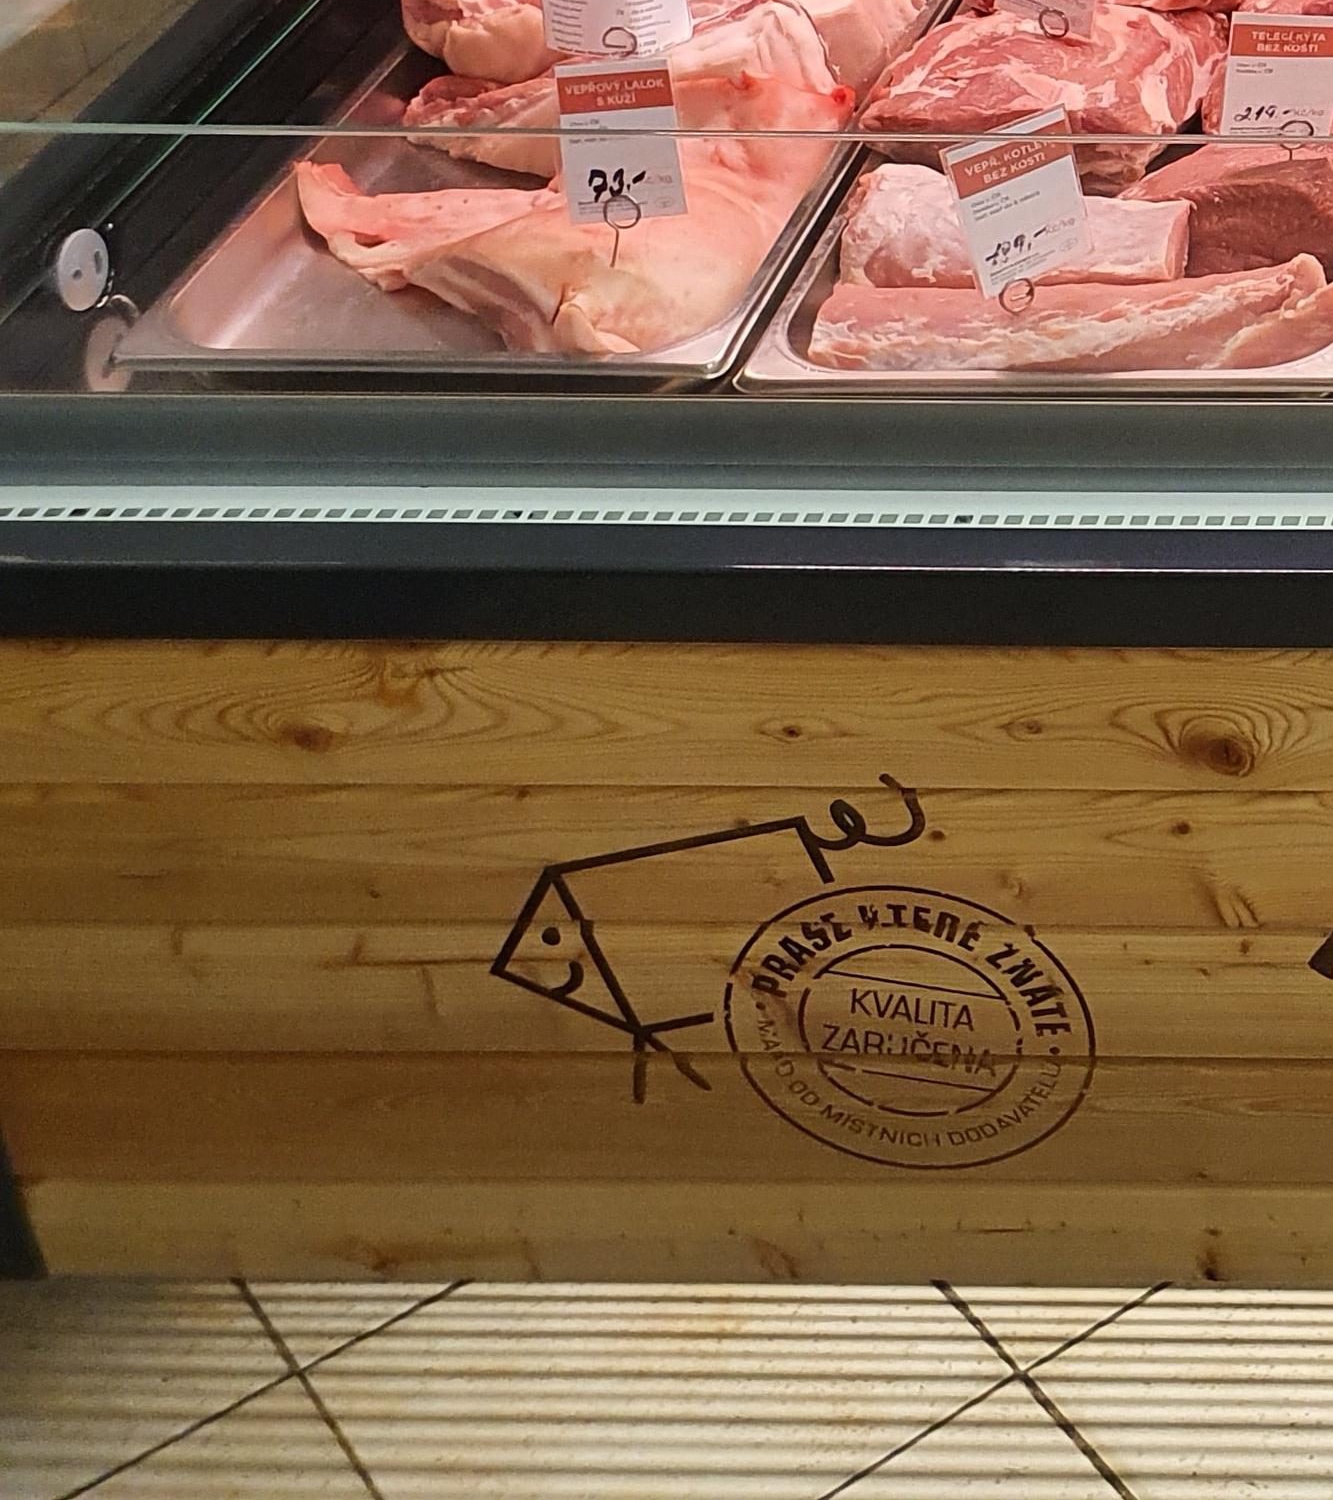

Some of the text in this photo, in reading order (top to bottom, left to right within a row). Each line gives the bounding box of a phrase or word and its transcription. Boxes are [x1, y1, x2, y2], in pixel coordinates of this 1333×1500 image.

[1256, 43, 1319, 53] BEZ KOSTI
[564, 77, 665, 96] VEPŘOVÝ LALOK
[982, 151, 1047, 184] BEZ KOSTI
[849, 987, 975, 1032] KVALITA
[821, 1023, 997, 1078] ZARUČENA
[788, 1078, 821, 1107] OD
